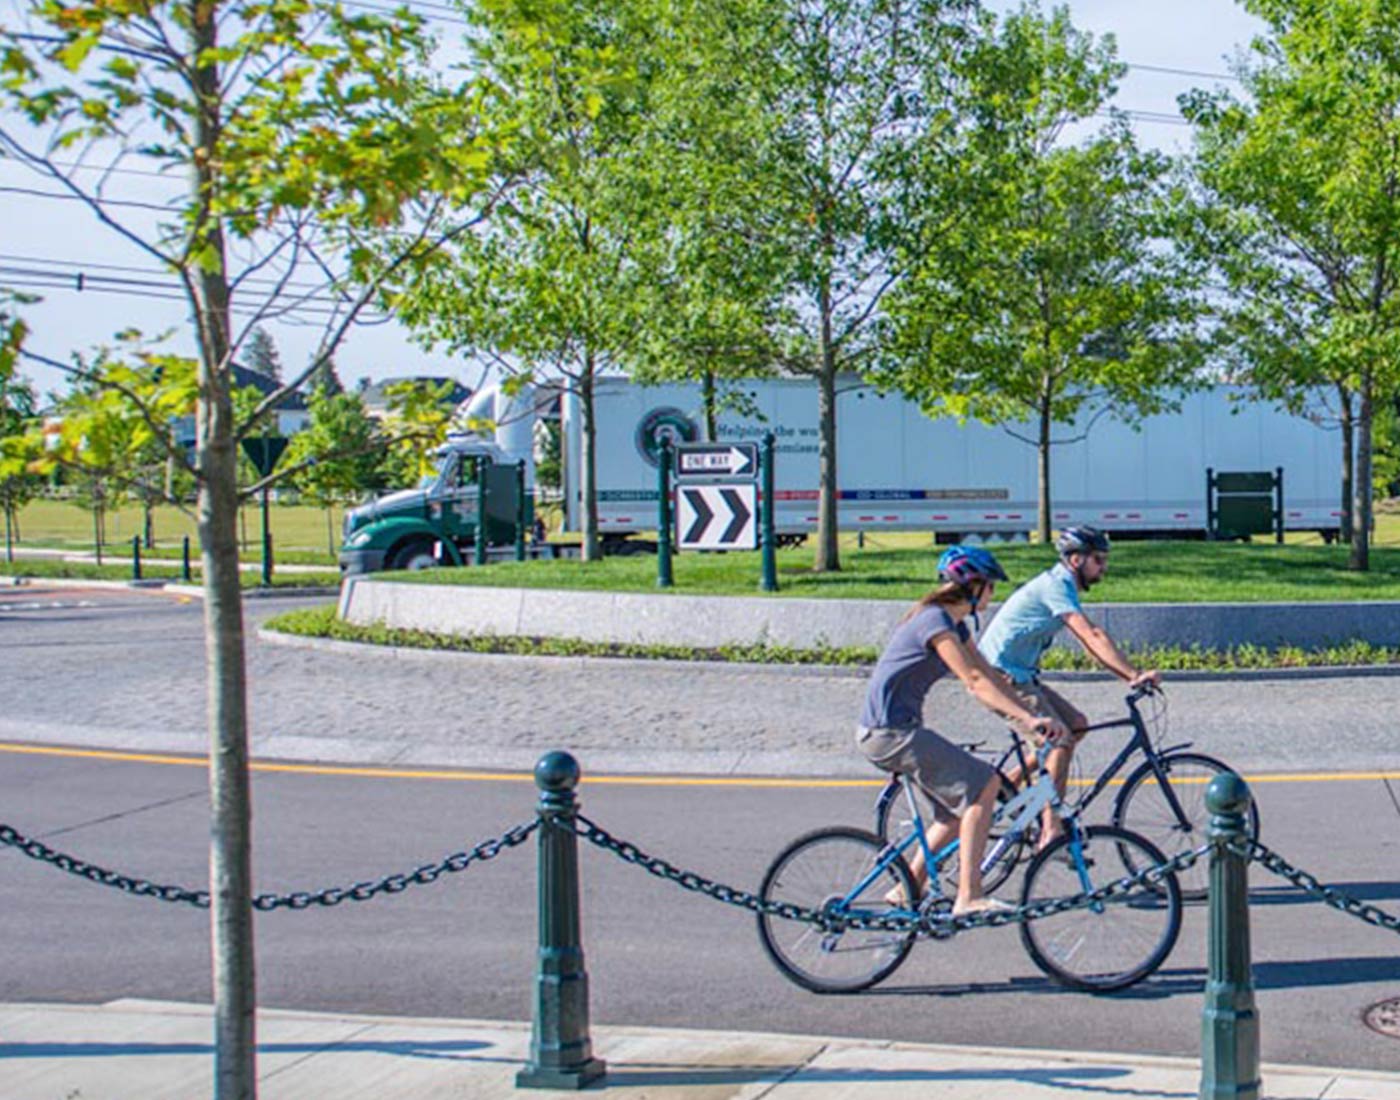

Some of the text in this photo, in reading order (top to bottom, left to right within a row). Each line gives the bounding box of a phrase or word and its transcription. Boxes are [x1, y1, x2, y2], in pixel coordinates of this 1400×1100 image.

[773, 424, 795, 437] the
[686, 455, 730, 467] ONE WAY
